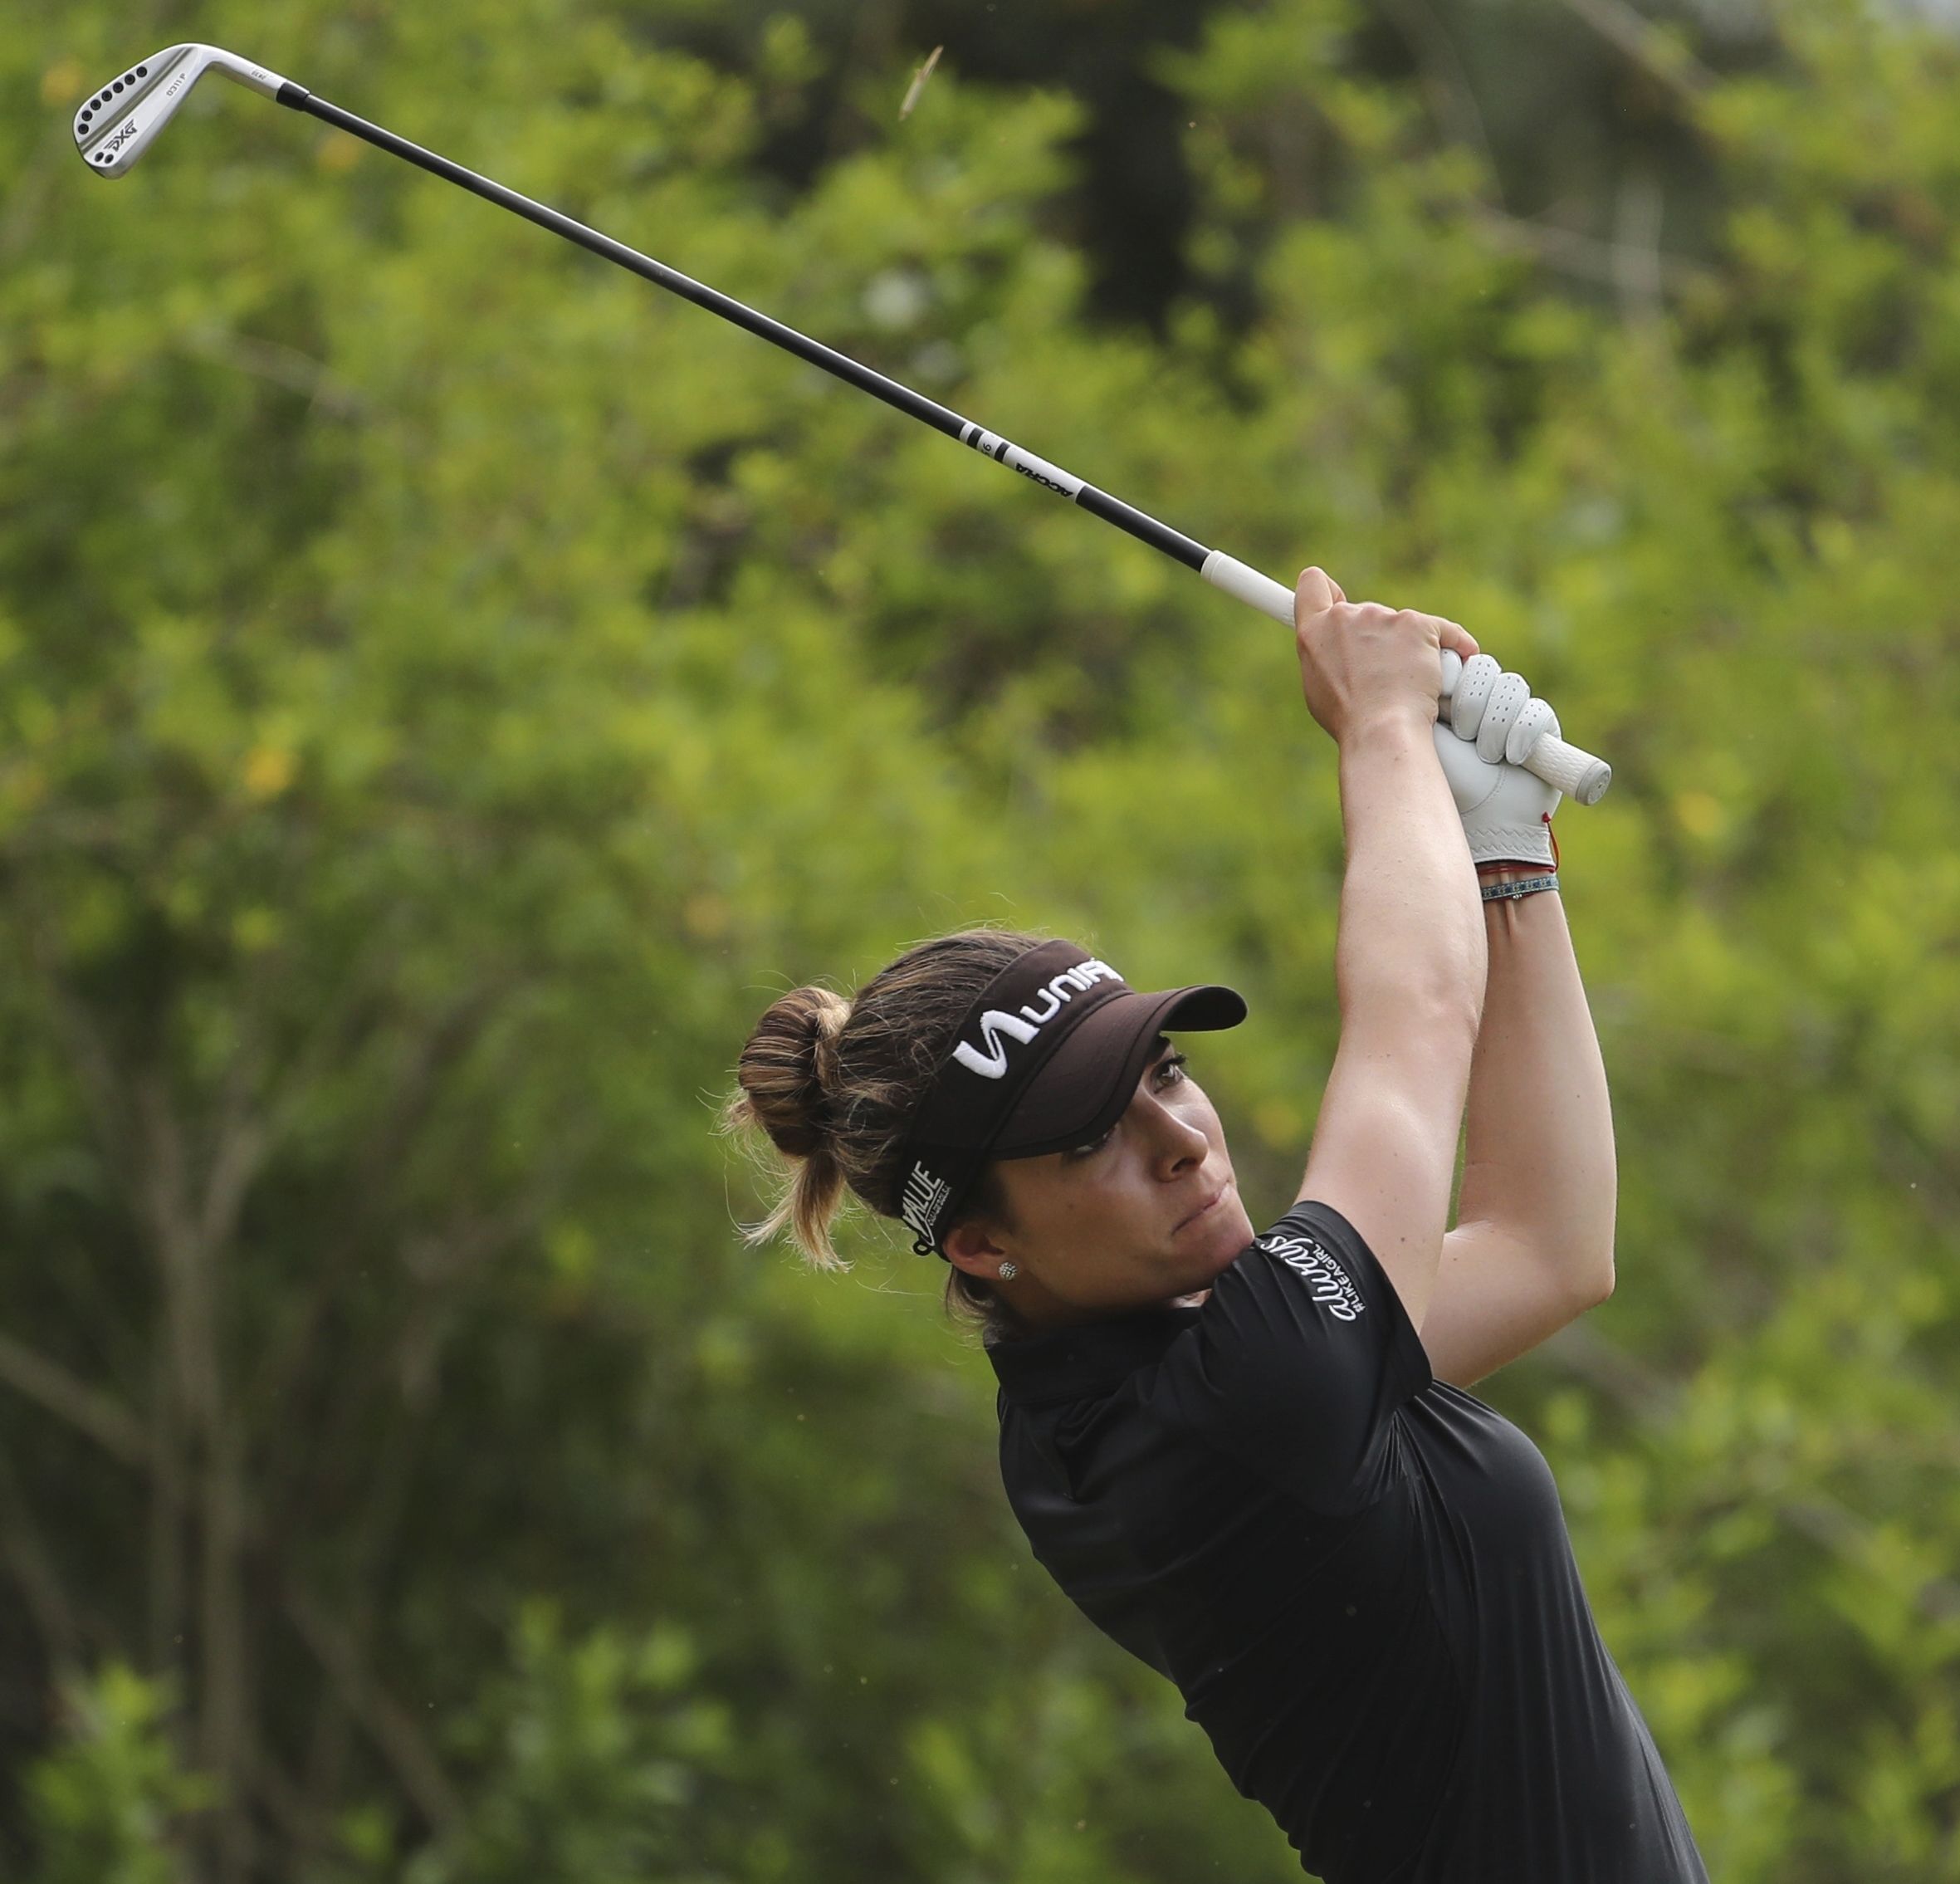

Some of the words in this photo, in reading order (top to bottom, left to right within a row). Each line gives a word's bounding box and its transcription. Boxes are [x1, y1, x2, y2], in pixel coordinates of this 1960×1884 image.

[166, 80, 182, 95] 0311
[104, 119, 138, 152] PXG
[1016, 462, 1074, 497] ACCRA
[902, 1161, 941, 1245] VALUE
[1260, 1236, 1356, 1321] always
[1313, 1244, 1366, 1313] #LIKEAGIRL
